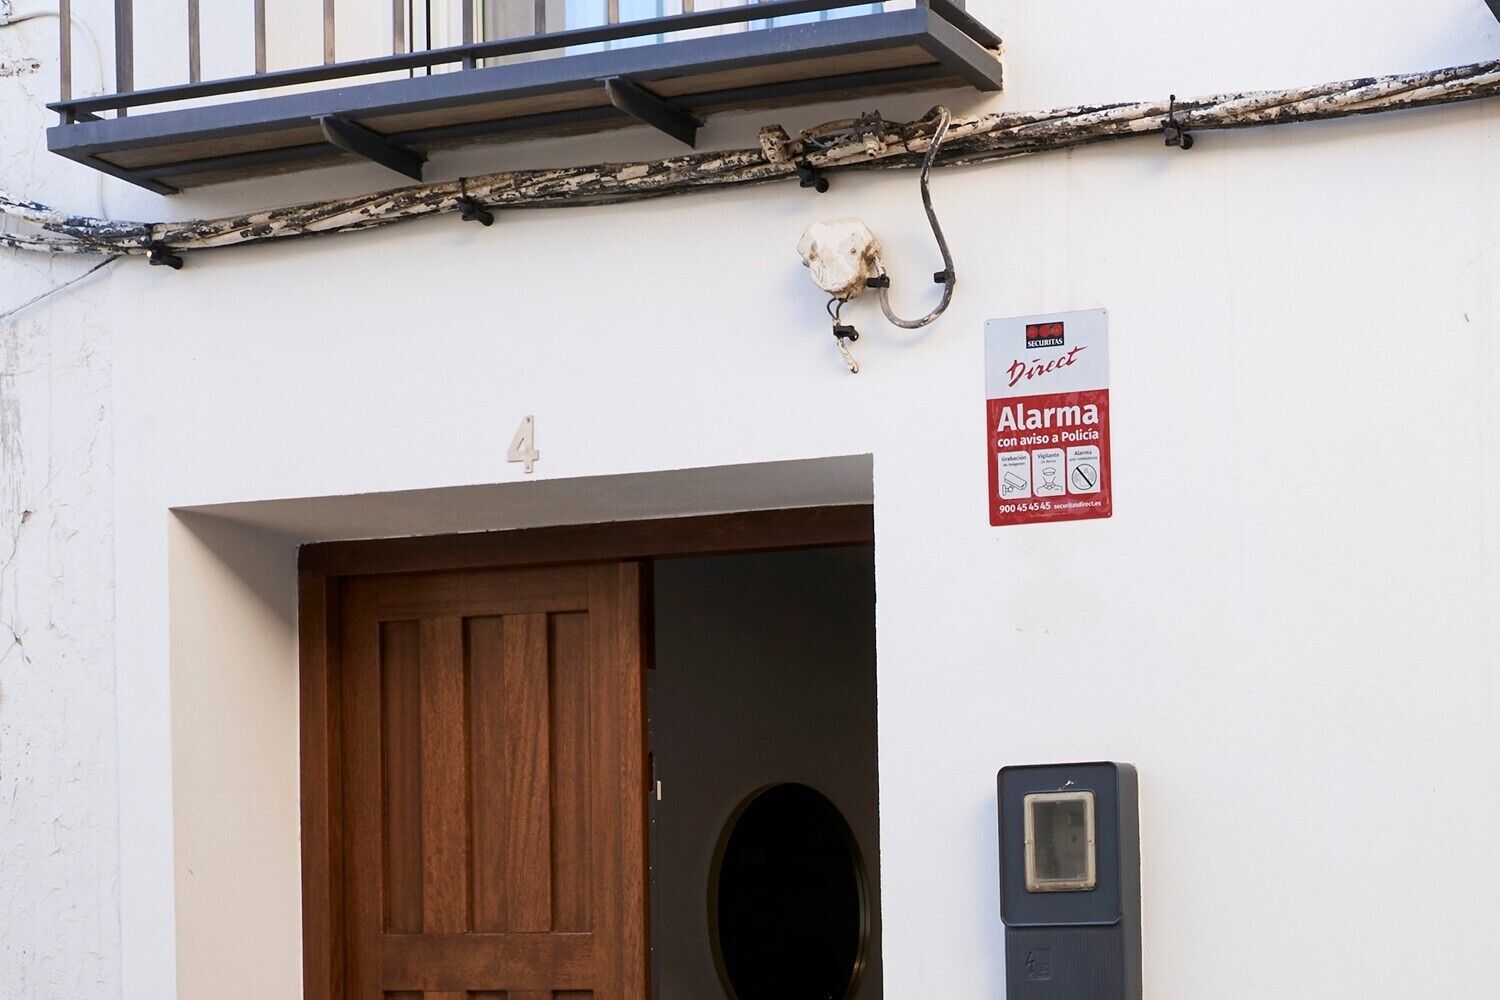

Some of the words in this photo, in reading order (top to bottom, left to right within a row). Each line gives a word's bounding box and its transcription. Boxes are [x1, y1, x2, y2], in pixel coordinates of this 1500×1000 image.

[1027, 338, 1063, 348] SECURITAS
[1005, 346, 1088, 387] Direct
[997, 403, 1099, 432] Alarma
[507, 415, 539, 473] 4
[997, 437, 1017, 447] con
[1020, 433, 1049, 446] aviso
[1052, 434, 1059, 443] a
[1061, 427, 1099, 442] Policía
[999, 504, 1016, 514] 900
[1017, 503, 1027, 512] 45
[1028, 503, 1039, 511] 45
[1040, 501, 1051, 510] 45
